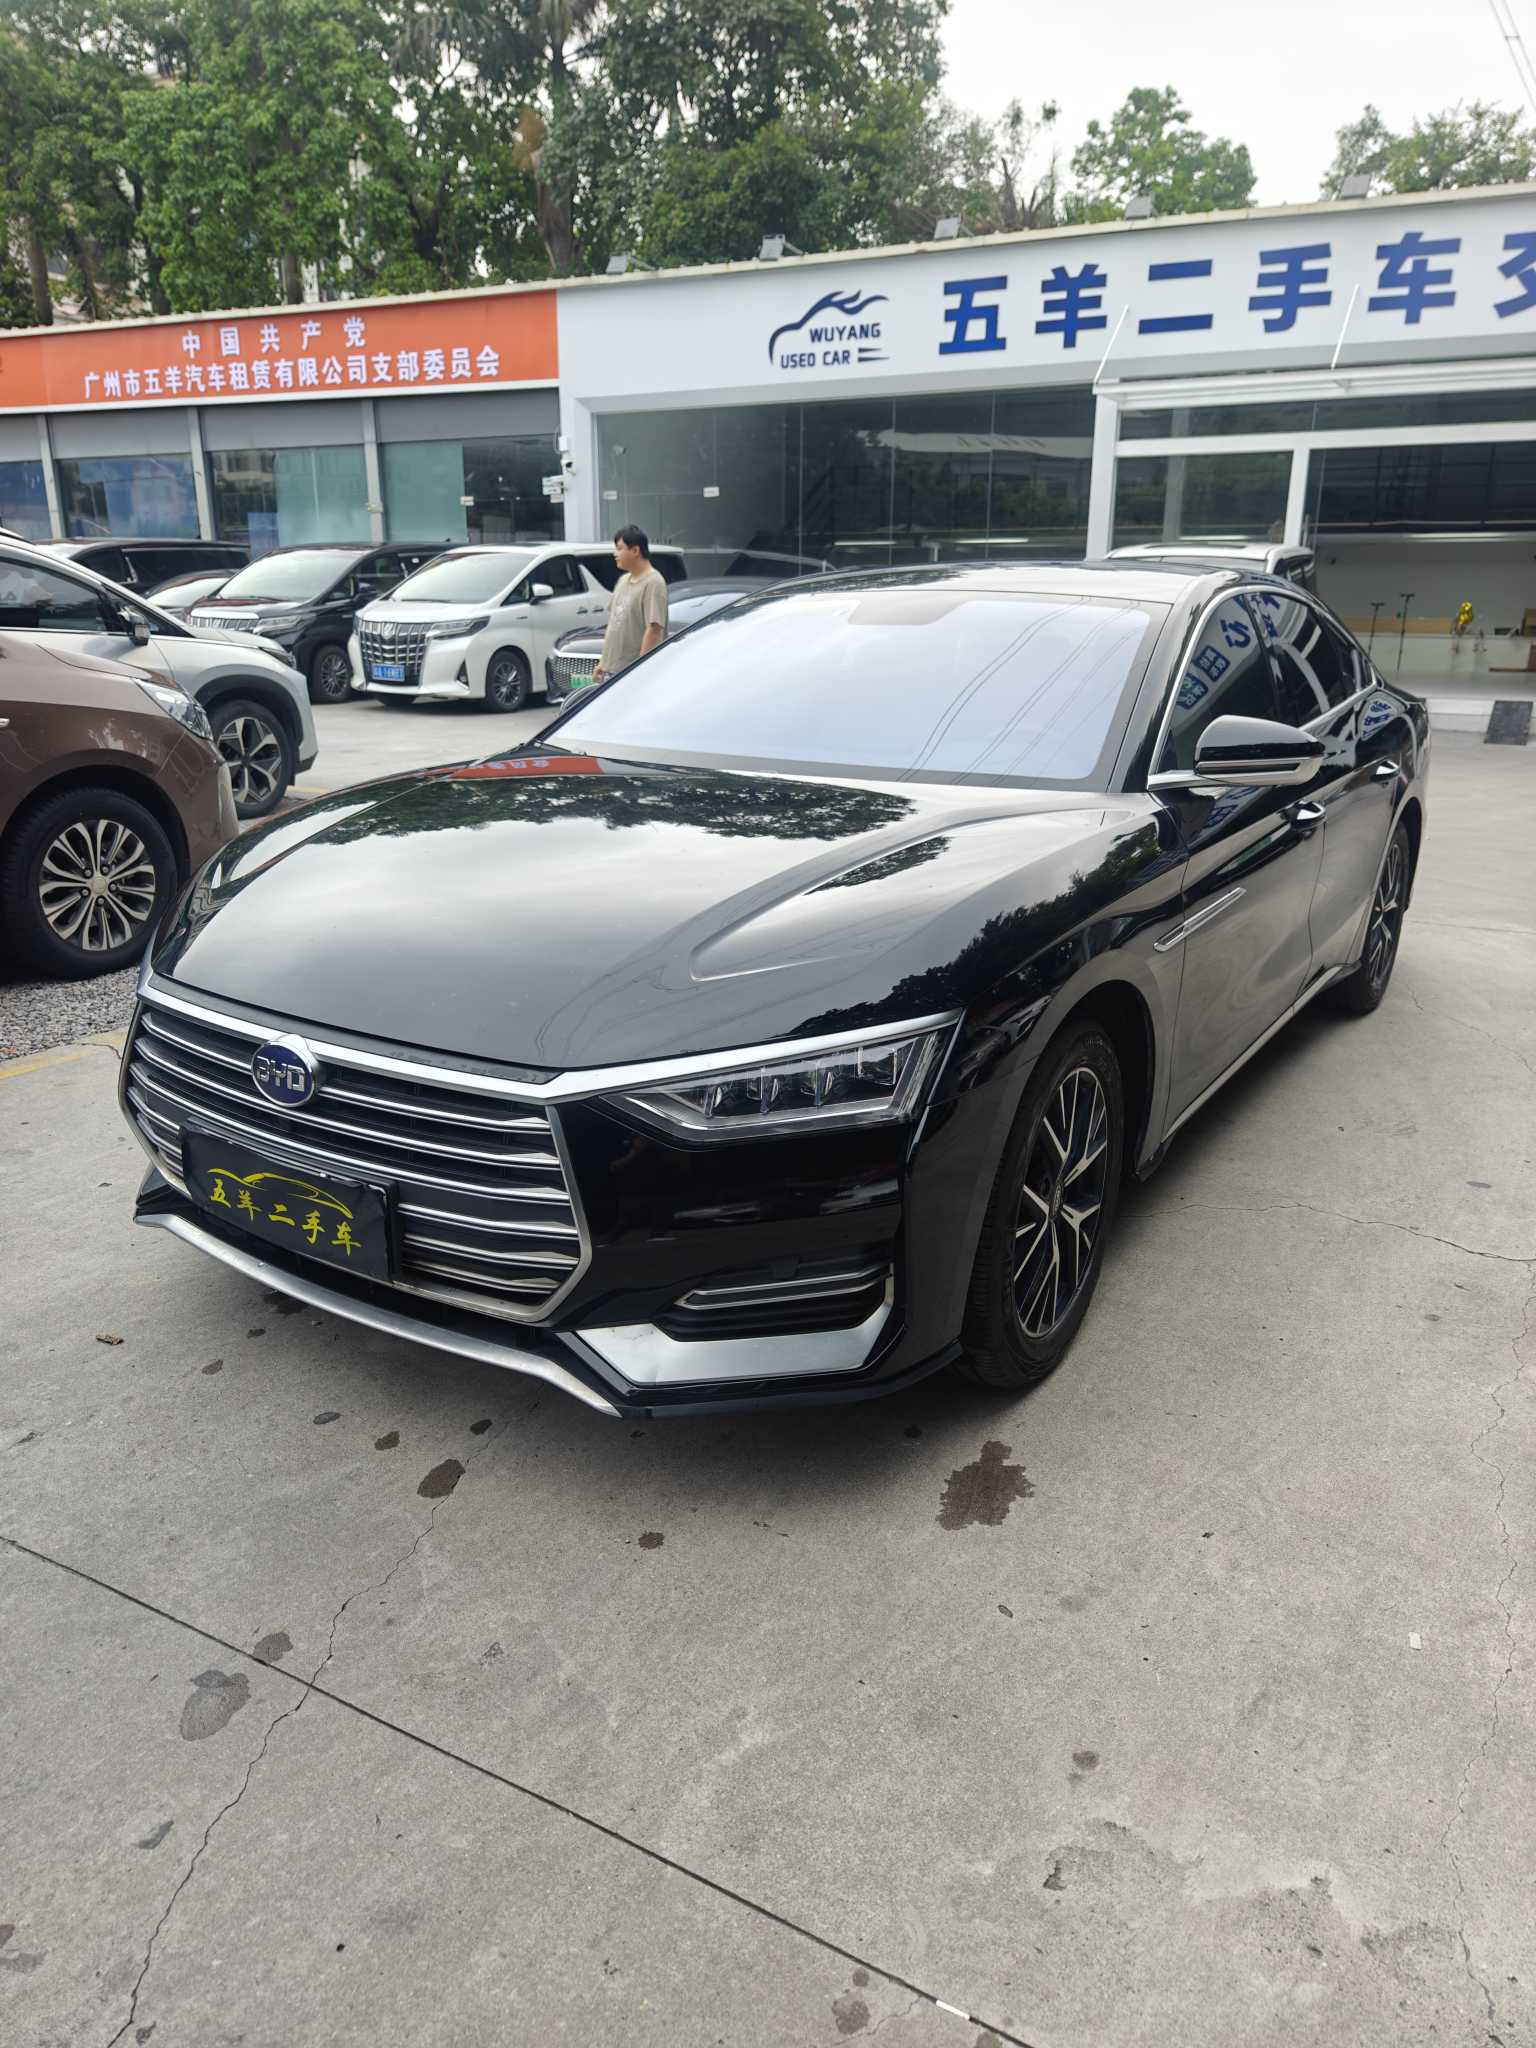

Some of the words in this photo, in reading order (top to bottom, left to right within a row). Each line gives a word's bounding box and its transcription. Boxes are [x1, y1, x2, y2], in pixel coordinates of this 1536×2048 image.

[181, 315, 366, 359] 中国共产党
[809, 322, 881, 343] WUYANG
[83, 344, 500, 399] 广州市五羊汽车租赁有限公司支部委员会
[780, 352, 816, 370] USED
[822, 350, 851, 367] CAR
[256, 1055, 305, 1092] BYD
[209, 1178, 362, 1257] 五羊二手车
